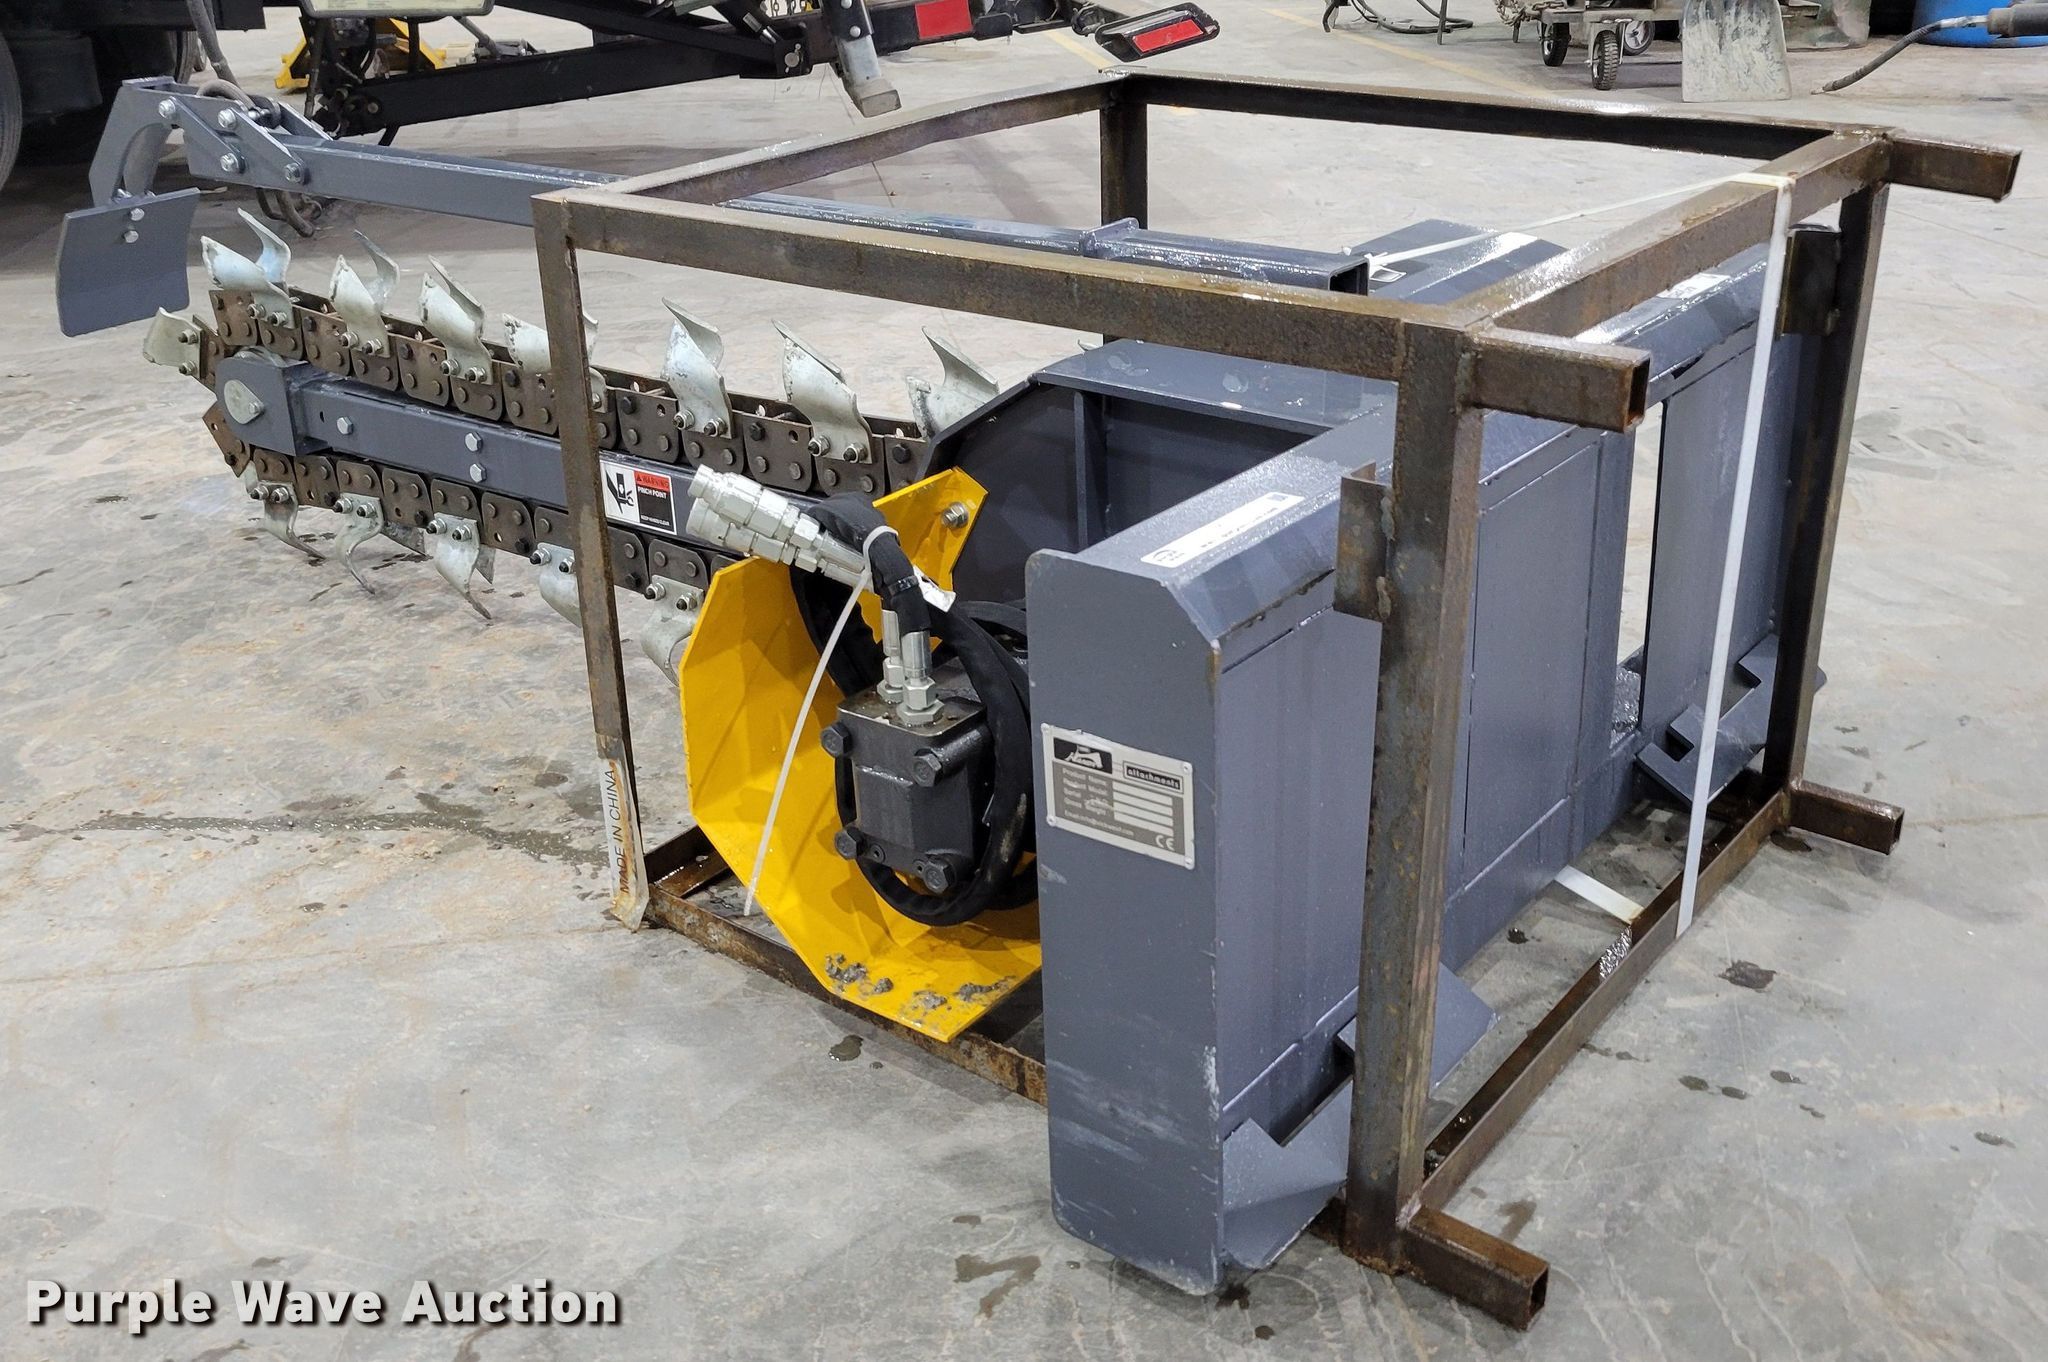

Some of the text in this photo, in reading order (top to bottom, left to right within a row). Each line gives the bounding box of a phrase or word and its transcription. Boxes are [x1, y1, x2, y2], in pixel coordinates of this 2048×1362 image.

[637, 486, 667, 499] PINCH POINT
[1127, 768, 1180, 789] attachments
[604, 769, 630, 894] MADE IN CHINA
